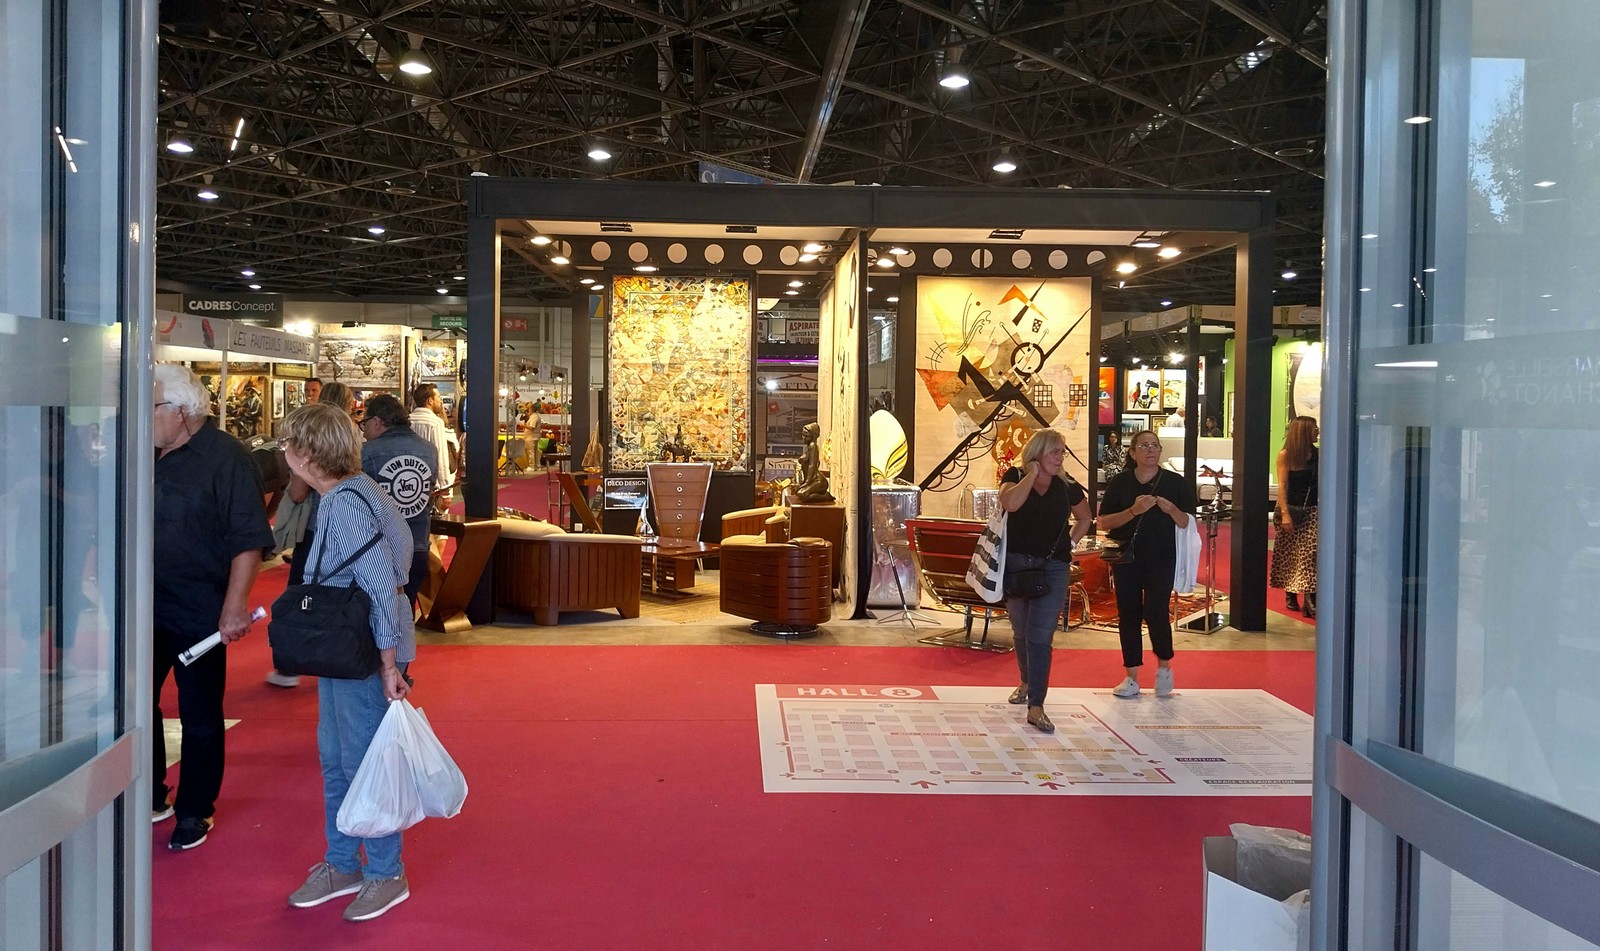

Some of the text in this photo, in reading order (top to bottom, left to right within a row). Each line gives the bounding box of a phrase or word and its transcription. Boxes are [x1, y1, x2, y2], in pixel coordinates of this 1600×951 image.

[233, 331, 248, 347] LES
[250, 334, 282, 352] FAUTEUILS
[385, 458, 428, 475] VON DUTCH
[797, 687, 878, 697] HALL
